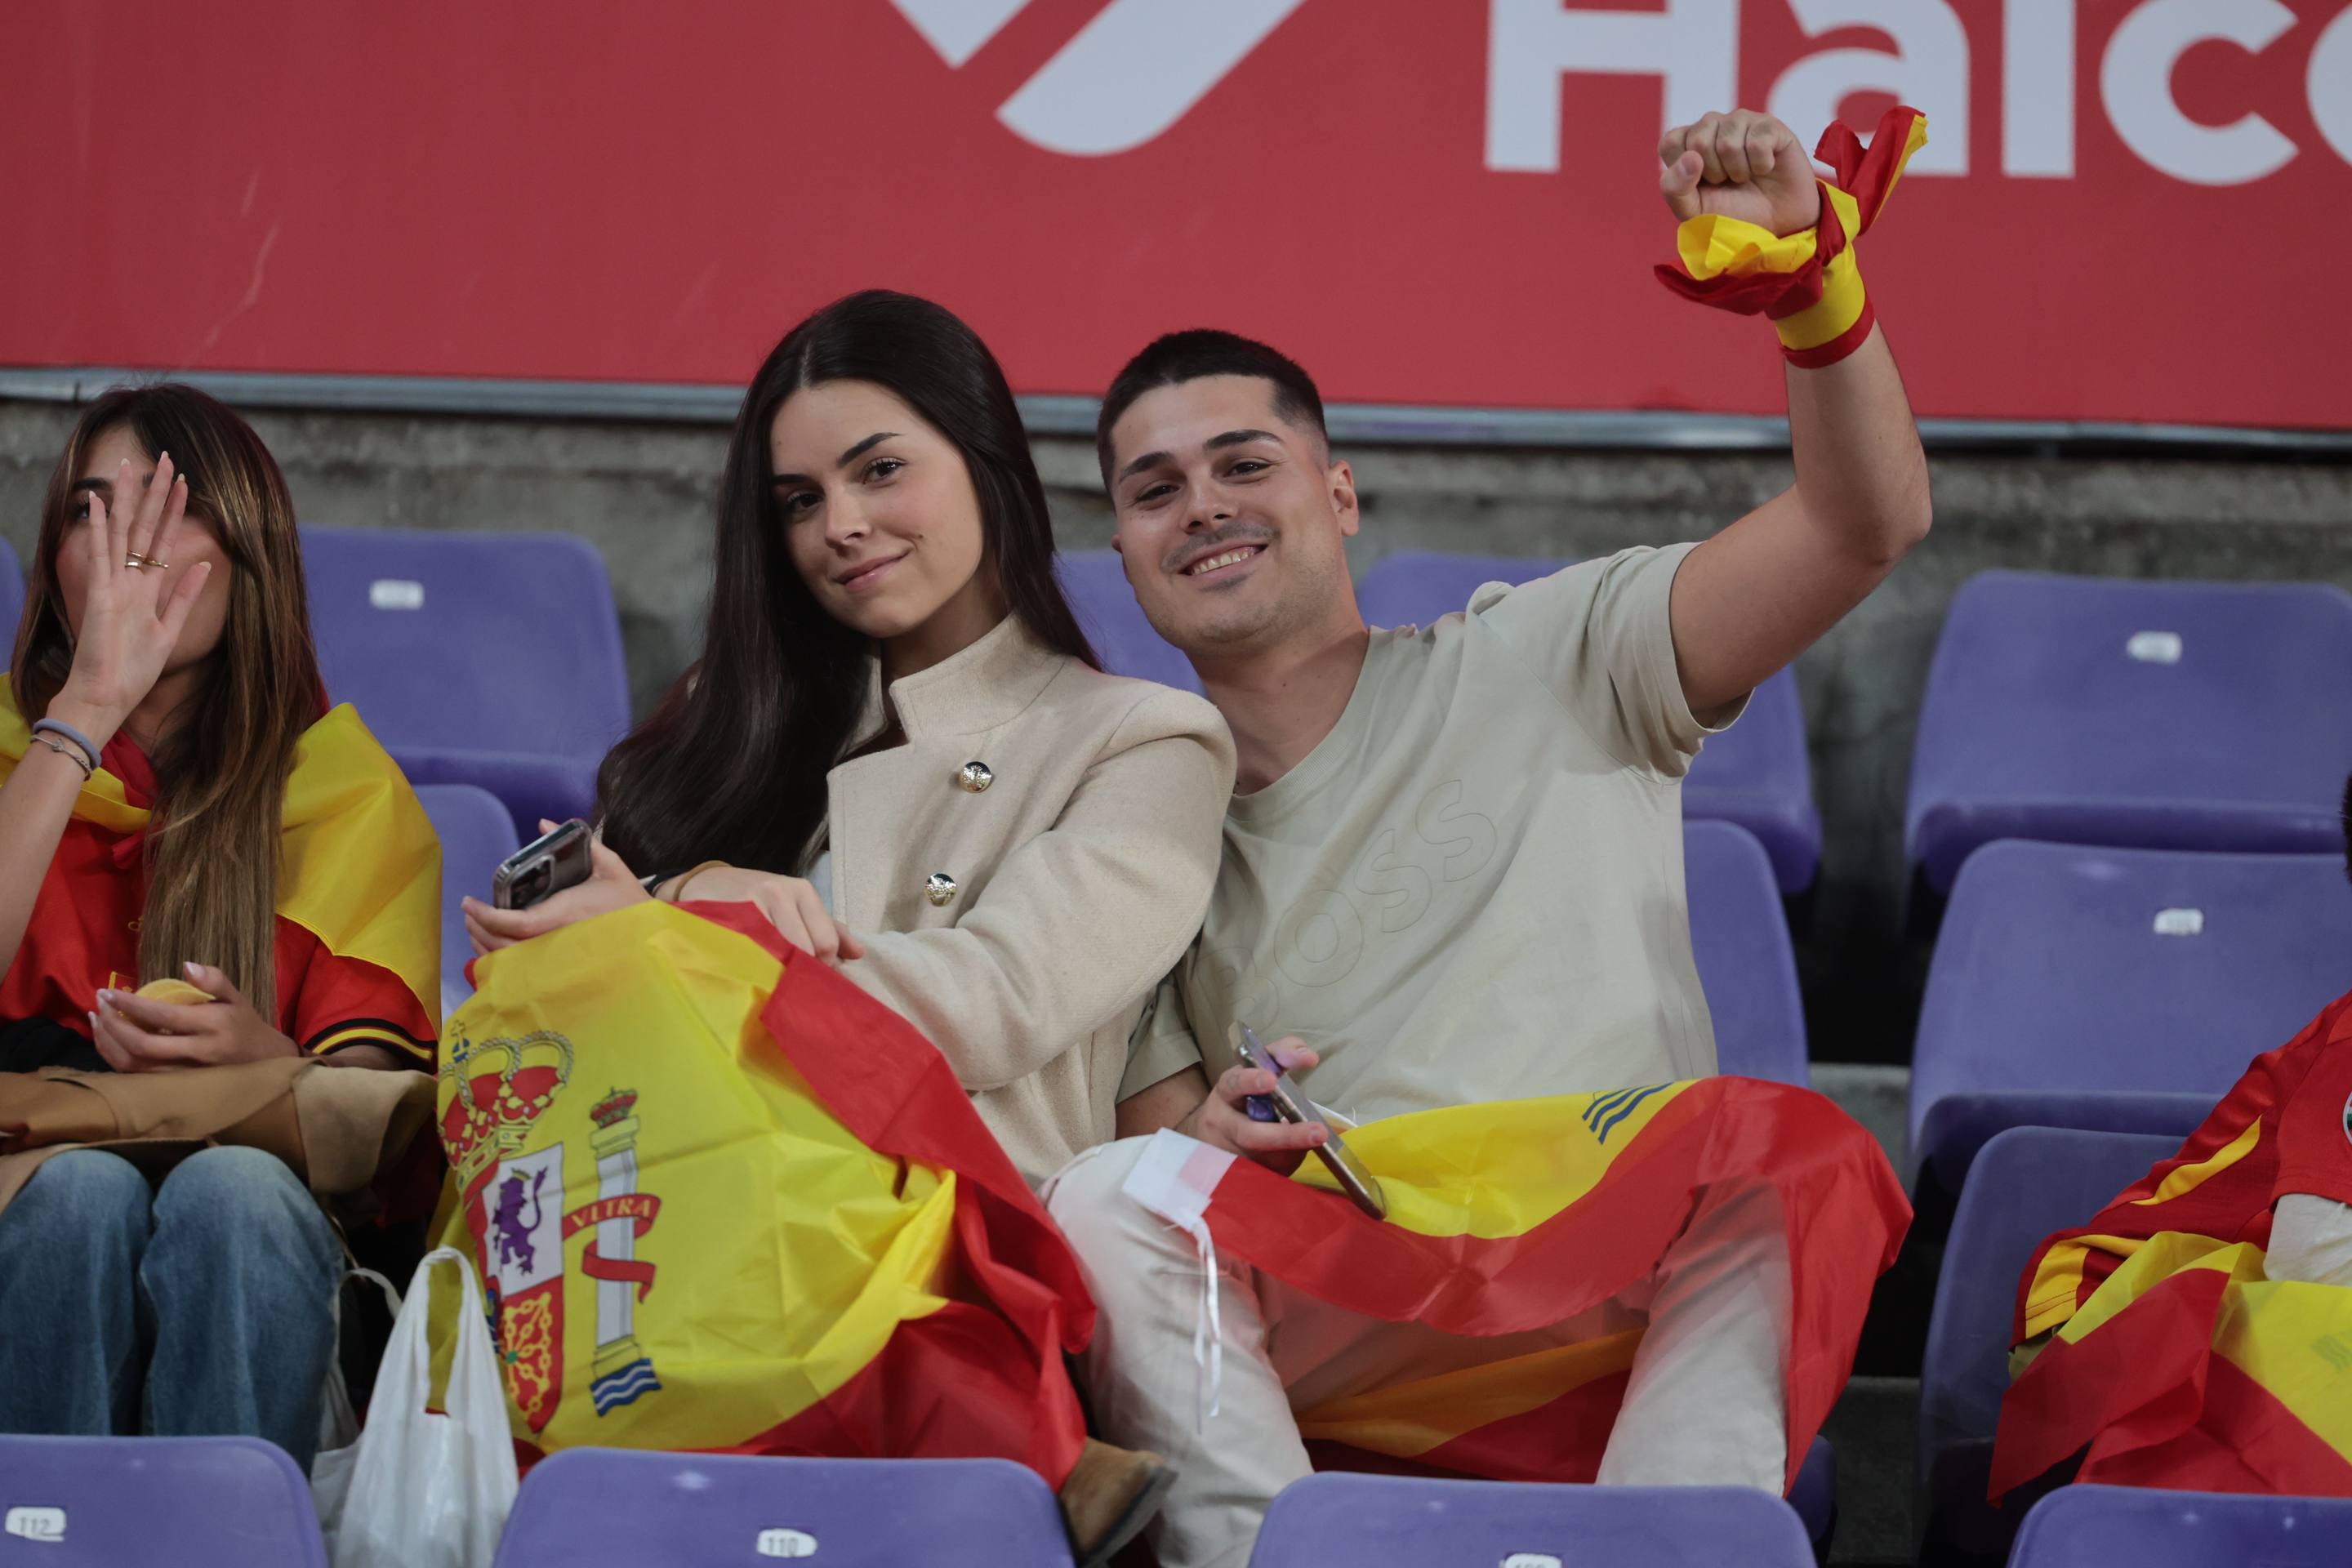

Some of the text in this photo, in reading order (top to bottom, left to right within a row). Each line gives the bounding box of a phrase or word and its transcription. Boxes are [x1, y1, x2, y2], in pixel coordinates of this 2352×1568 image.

[1485, 0, 2352, 185] Halc
[572, 1197, 651, 1227] VLTRA
[18, 1516, 56, 1536] 112
